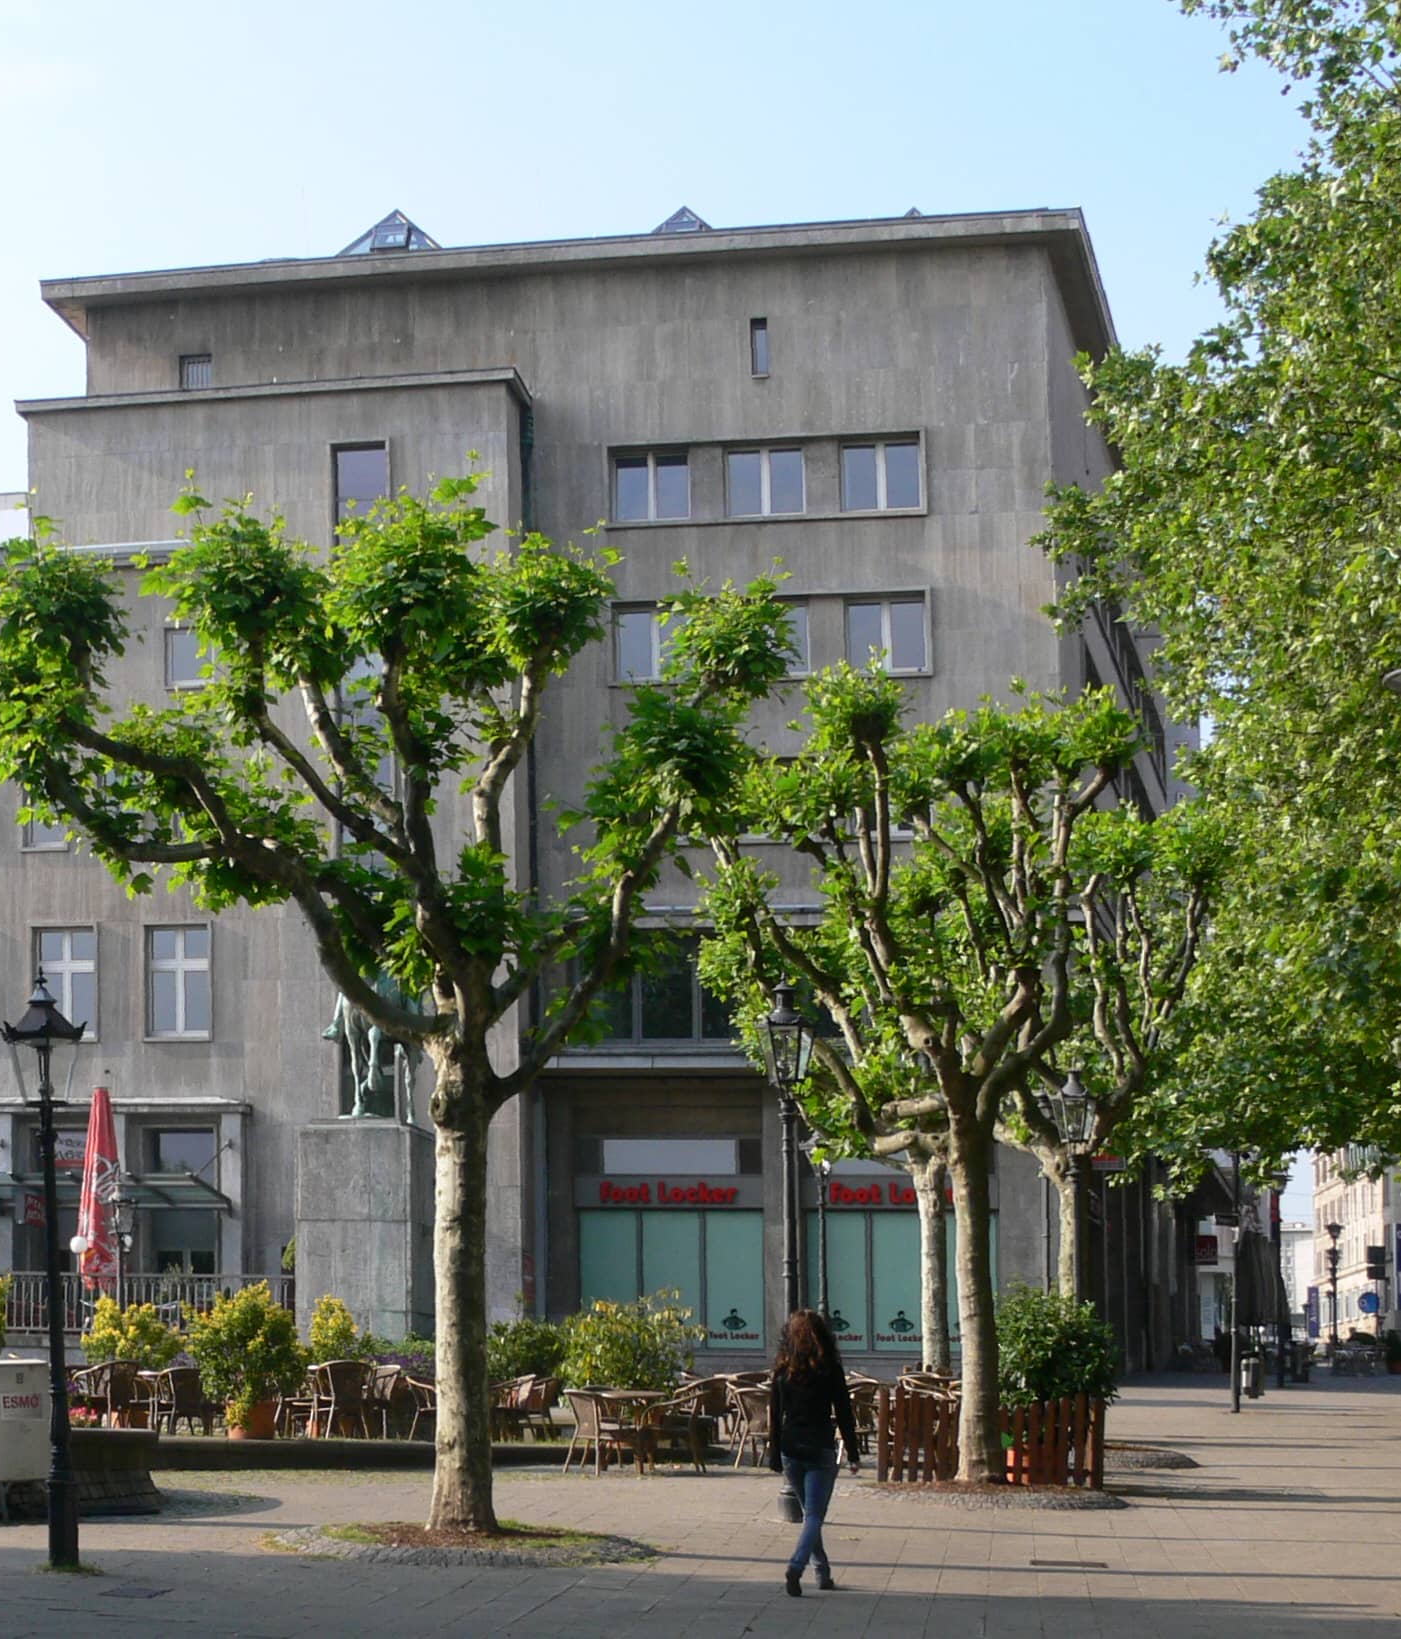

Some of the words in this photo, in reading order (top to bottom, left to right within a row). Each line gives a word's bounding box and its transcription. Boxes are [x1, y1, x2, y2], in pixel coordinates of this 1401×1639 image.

[600, 1181, 650, 1204] Foot
[657, 1181, 738, 1204] Locker
[829, 1182, 882, 1204] Foot
